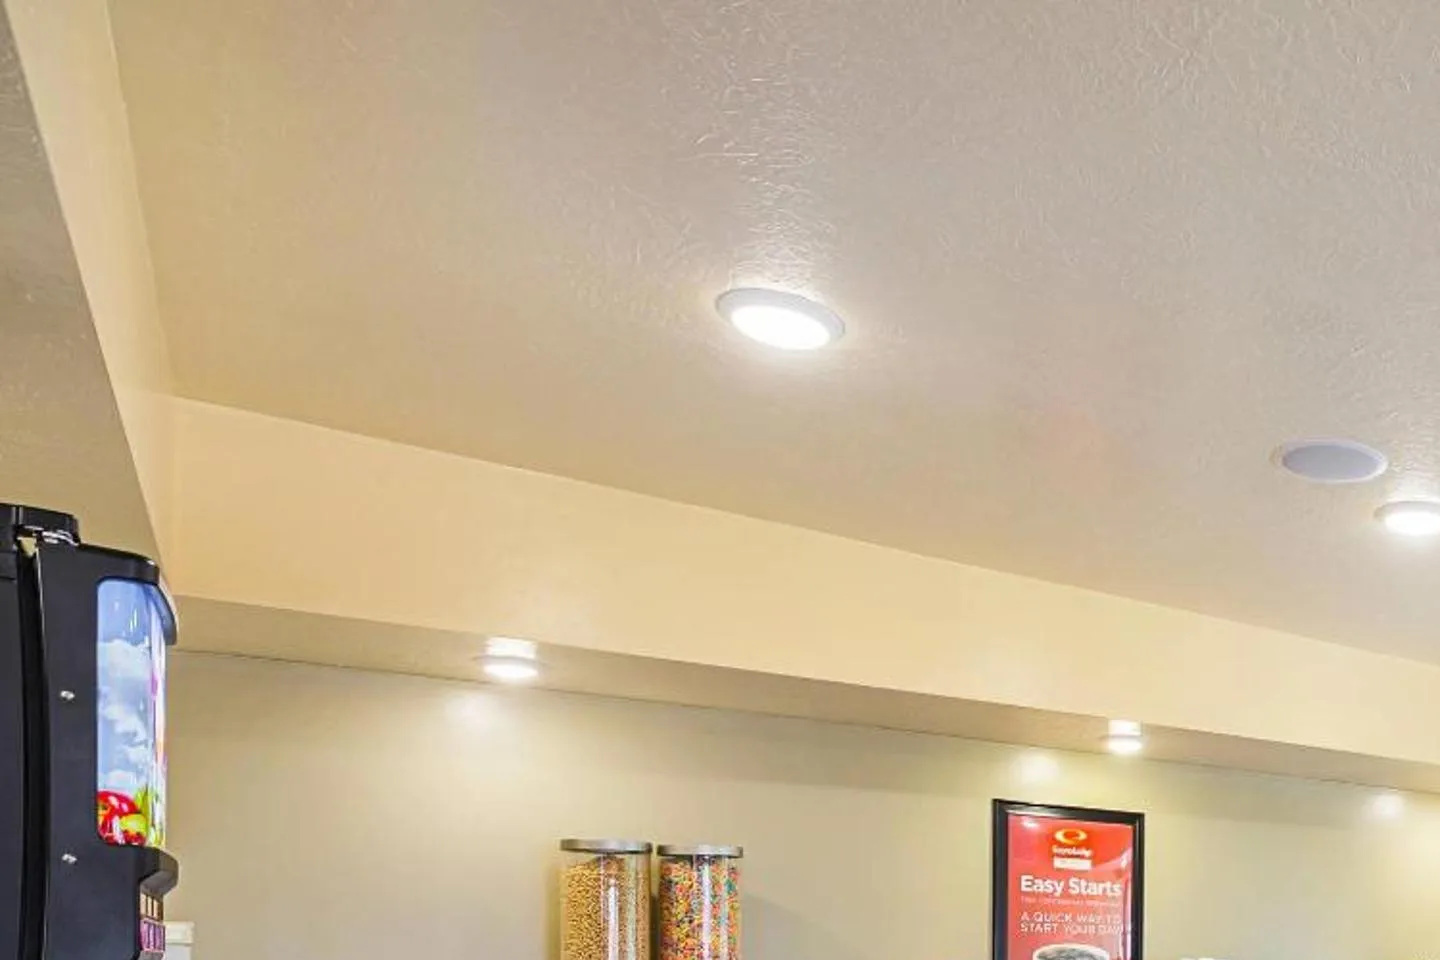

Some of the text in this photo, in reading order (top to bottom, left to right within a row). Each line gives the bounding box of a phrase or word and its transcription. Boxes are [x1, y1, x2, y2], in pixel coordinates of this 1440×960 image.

[1020, 875, 1121, 897] Easy Starts
[1020, 911, 1030, 922] A
[1033, 911, 1073, 923] QUICK
[1020, 922, 1058, 934] START
[1063, 924, 1096, 935] YOUR
